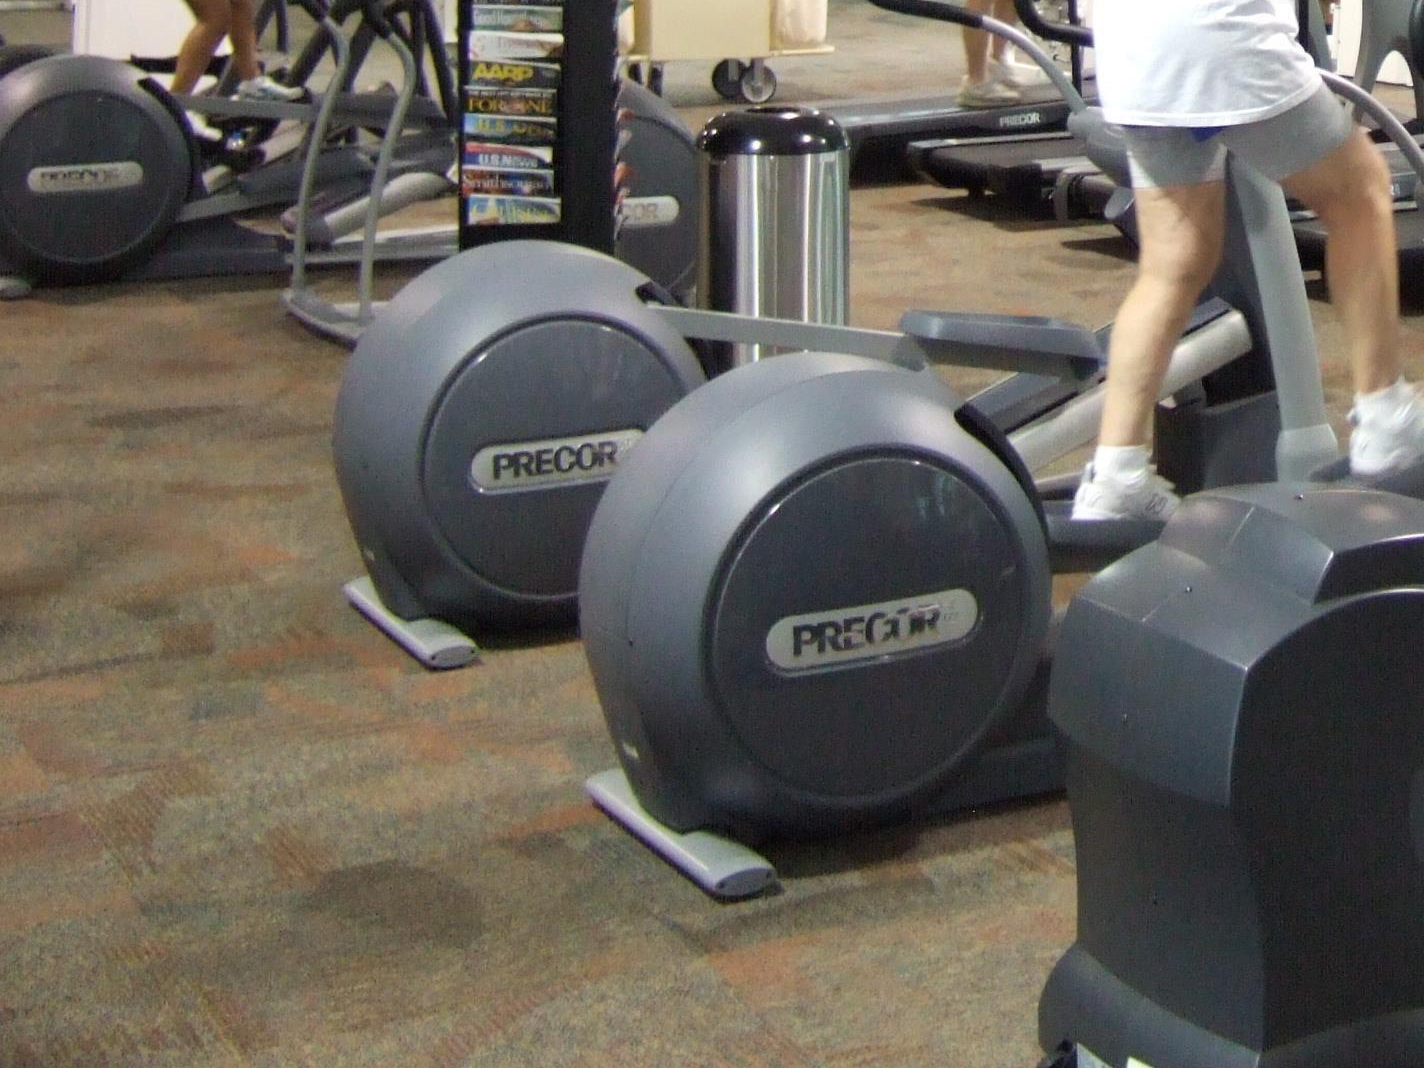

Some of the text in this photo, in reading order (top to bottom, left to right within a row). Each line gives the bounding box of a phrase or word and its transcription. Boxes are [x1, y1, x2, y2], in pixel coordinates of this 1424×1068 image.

[472, 63, 534, 82] AARP
[468, 97, 553, 112] FORNE
[999, 112, 1041, 128] PRECOR
[492, 441, 619, 480] PRECOR
